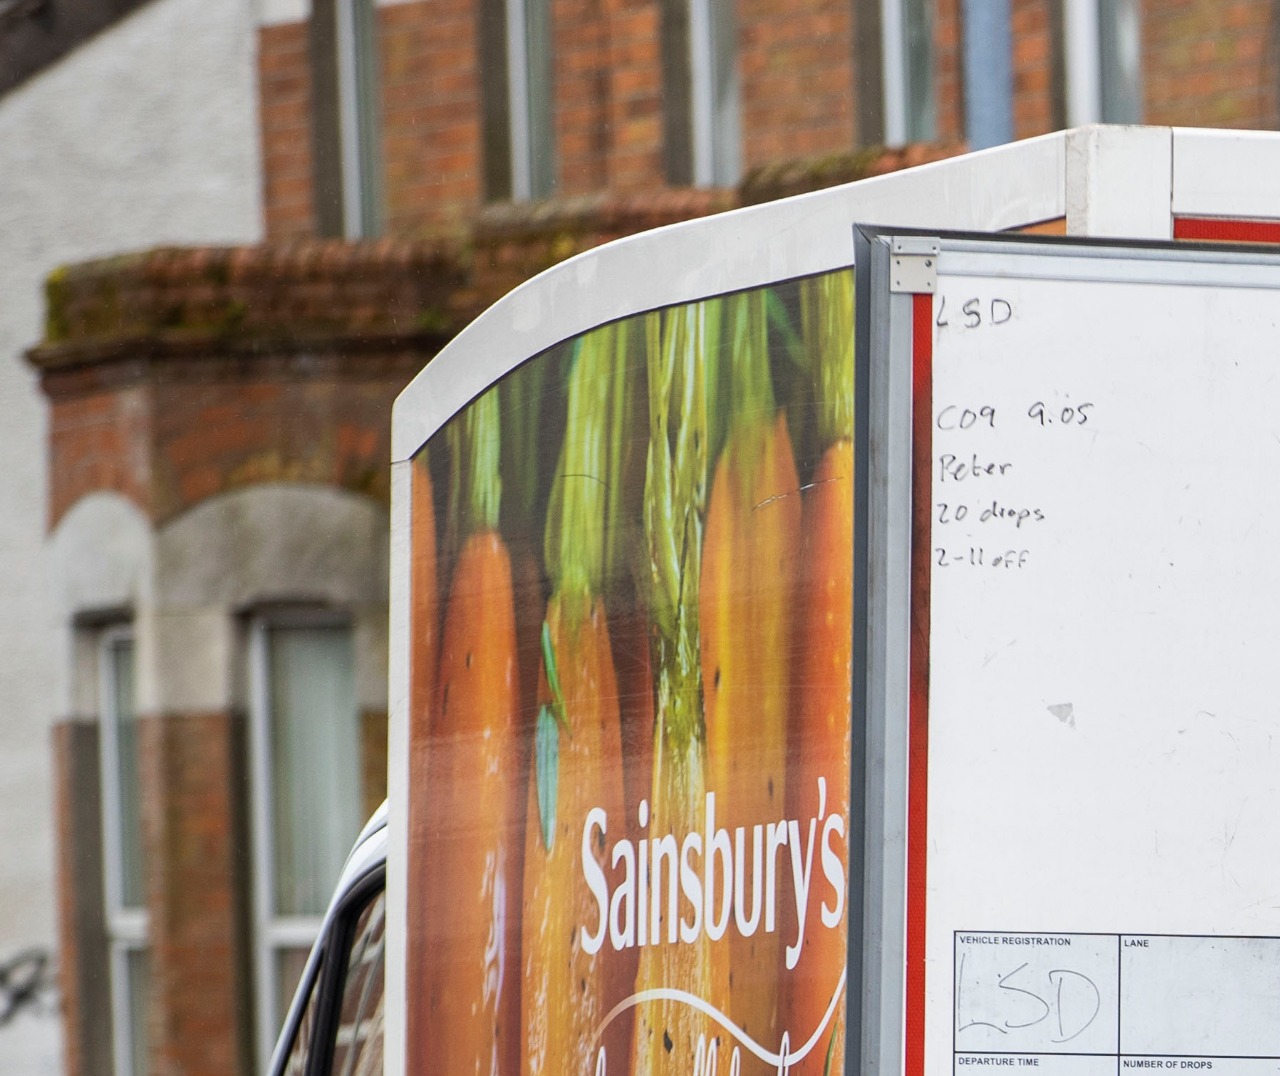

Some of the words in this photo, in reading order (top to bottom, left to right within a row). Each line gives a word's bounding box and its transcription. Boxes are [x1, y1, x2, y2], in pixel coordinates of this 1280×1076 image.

[937, 295, 1012, 328] LSD
[939, 453, 1013, 483] Peter
[937, 503, 968, 524] 20
[980, 500, 1045, 528] drops
[580, 776, 844, 970] Sainsbury's
[960, 936, 1000, 945] VEHICLE
[1002, 936, 1071, 946] REGISTRATION
[1124, 939, 1149, 948] LANE
[958, 953, 1100, 1043] LSD
[958, 1058, 1015, 1066] DEPARTURE
[1017, 1058, 1039, 1067] TIME
[1123, 1060, 1163, 1069] NUMBER
[1165, 1060, 1178, 1069] OF
[1180, 1060, 1212, 1070] DROPS
